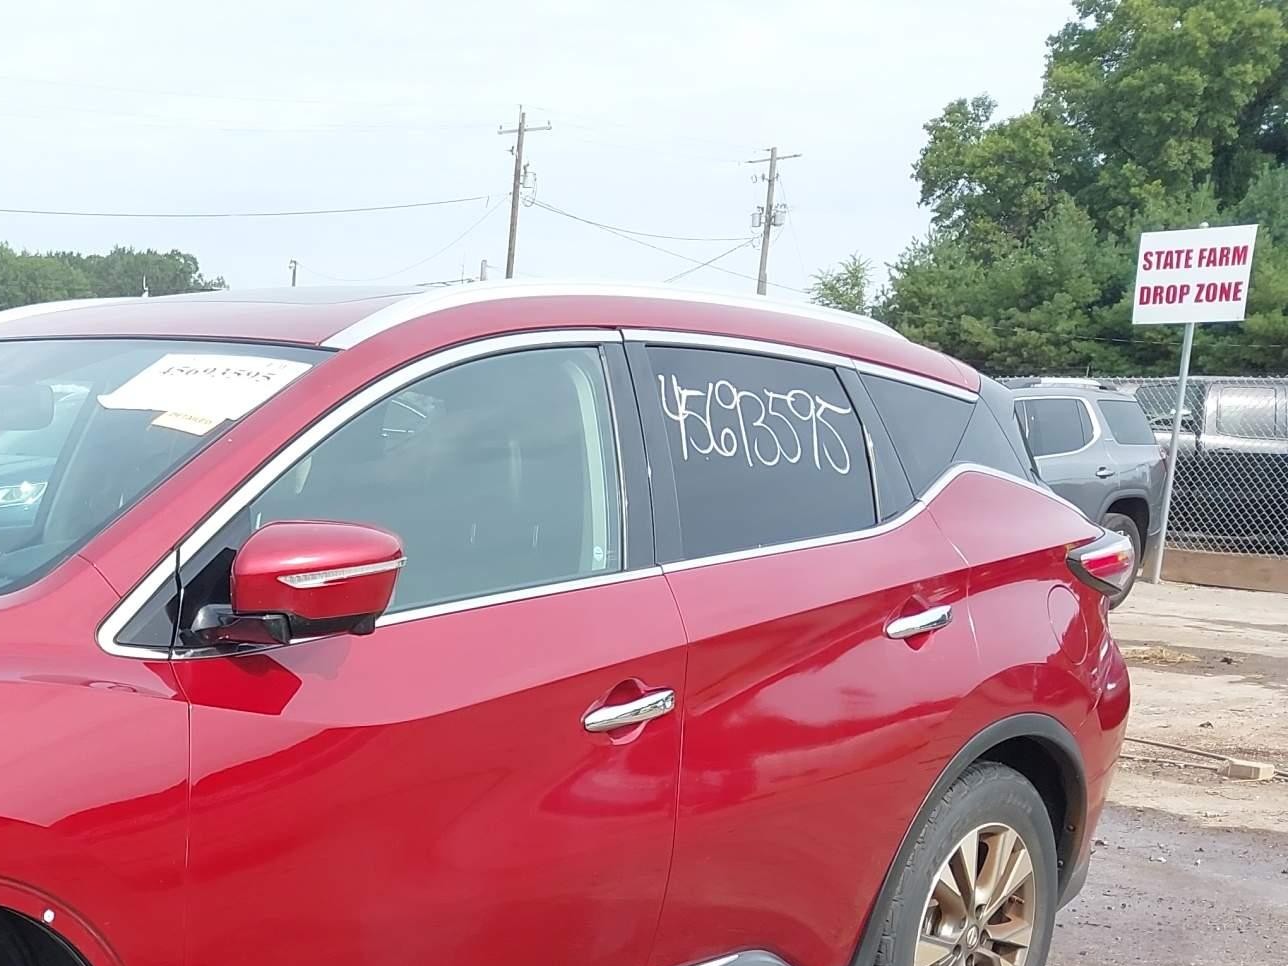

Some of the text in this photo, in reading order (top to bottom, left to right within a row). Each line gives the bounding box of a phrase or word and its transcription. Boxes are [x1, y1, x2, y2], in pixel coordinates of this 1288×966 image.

[1142, 244, 1249, 272] STATE FARM
[1138, 281, 1244, 306] DROP ZONE
[657, 374, 852, 475] 45693595
